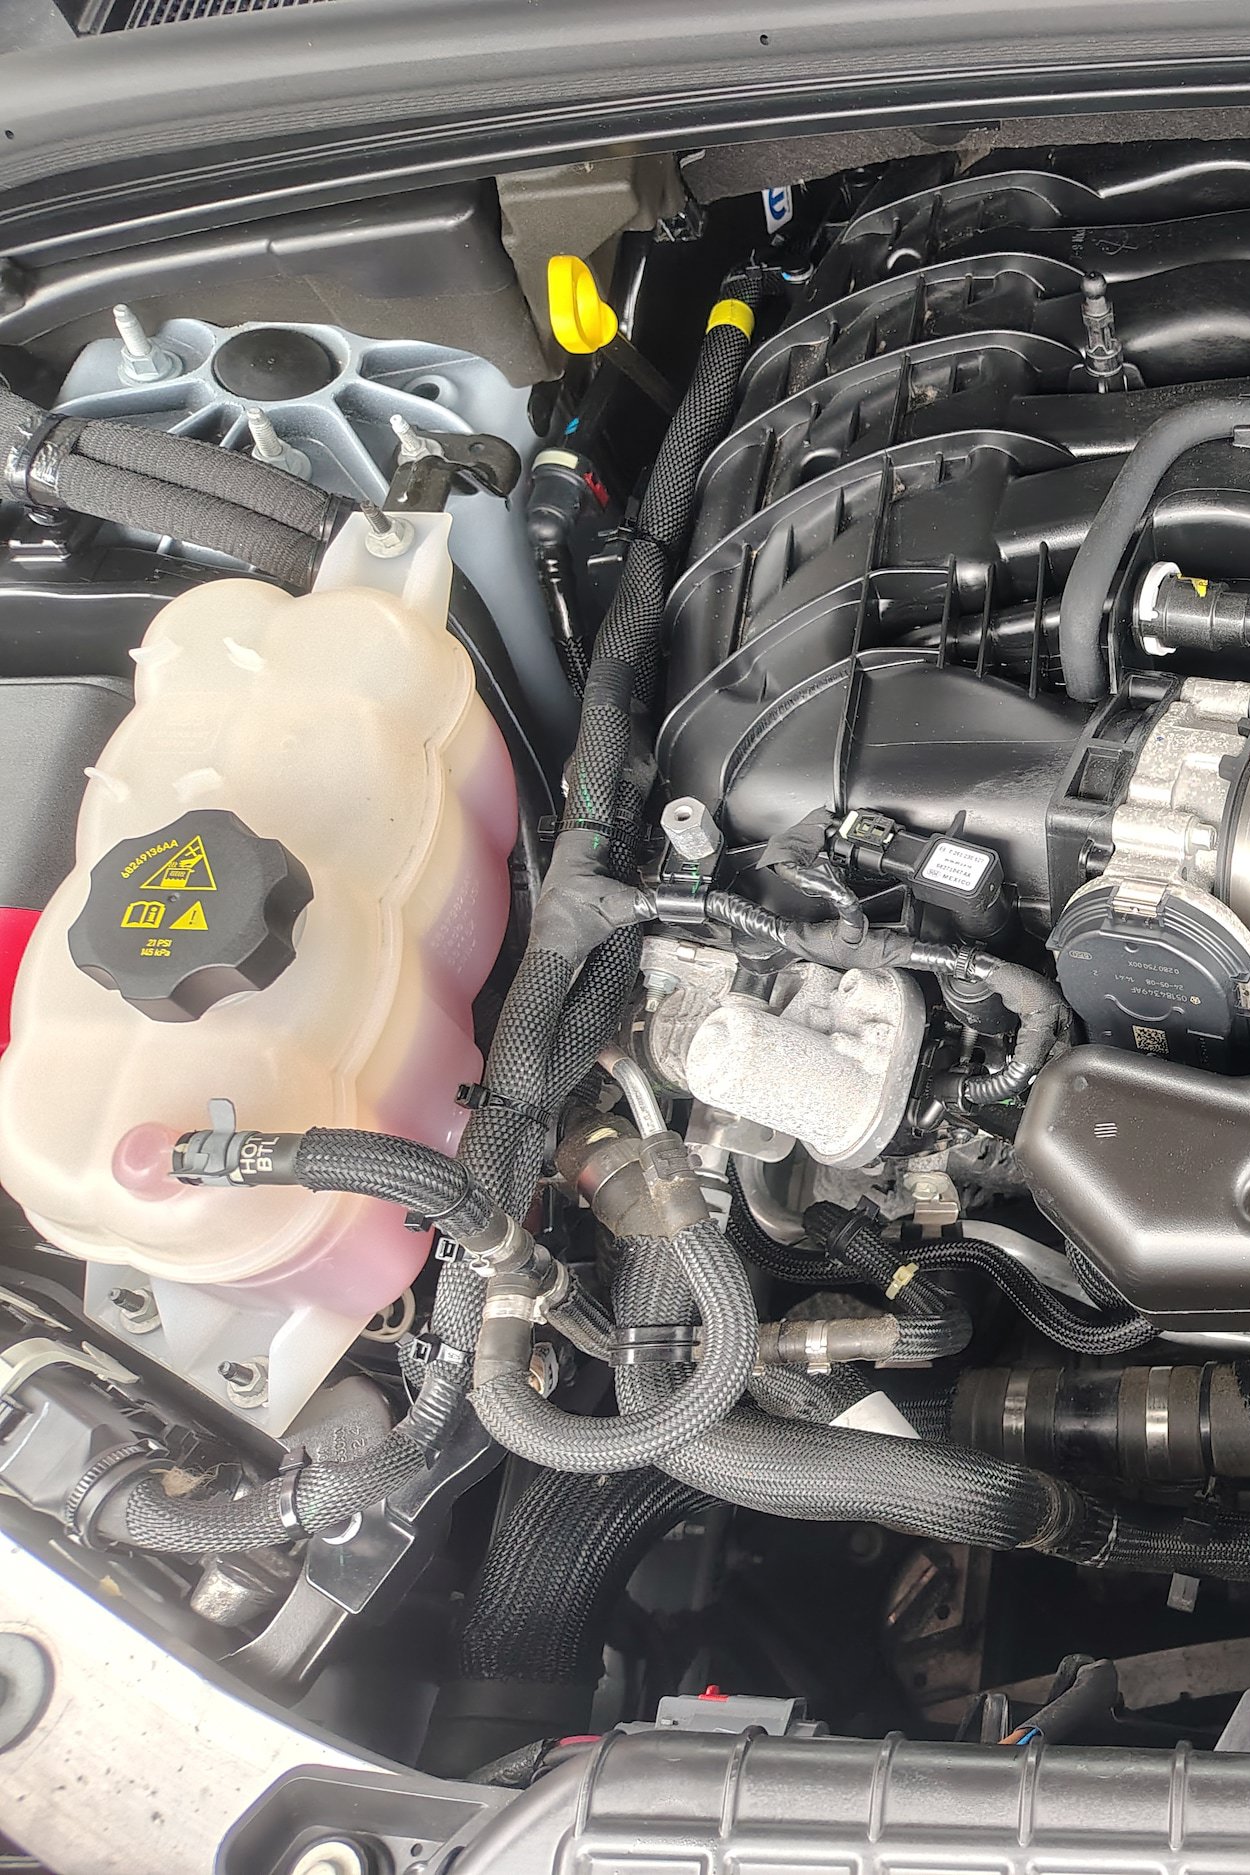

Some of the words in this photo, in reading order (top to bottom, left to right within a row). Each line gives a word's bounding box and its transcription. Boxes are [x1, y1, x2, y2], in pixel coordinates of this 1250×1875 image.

[120, 839, 179, 879] 68249136AA
[942, 874, 971, 886] MEXICO
[141, 948, 154, 957] 145
[154, 948, 171, 957] kPa
[146, 939, 156, 948] 21
[156, 939, 173, 948] PSI
[240, 1136, 263, 1175] HOT
[256, 1136, 280, 1172] BTL
